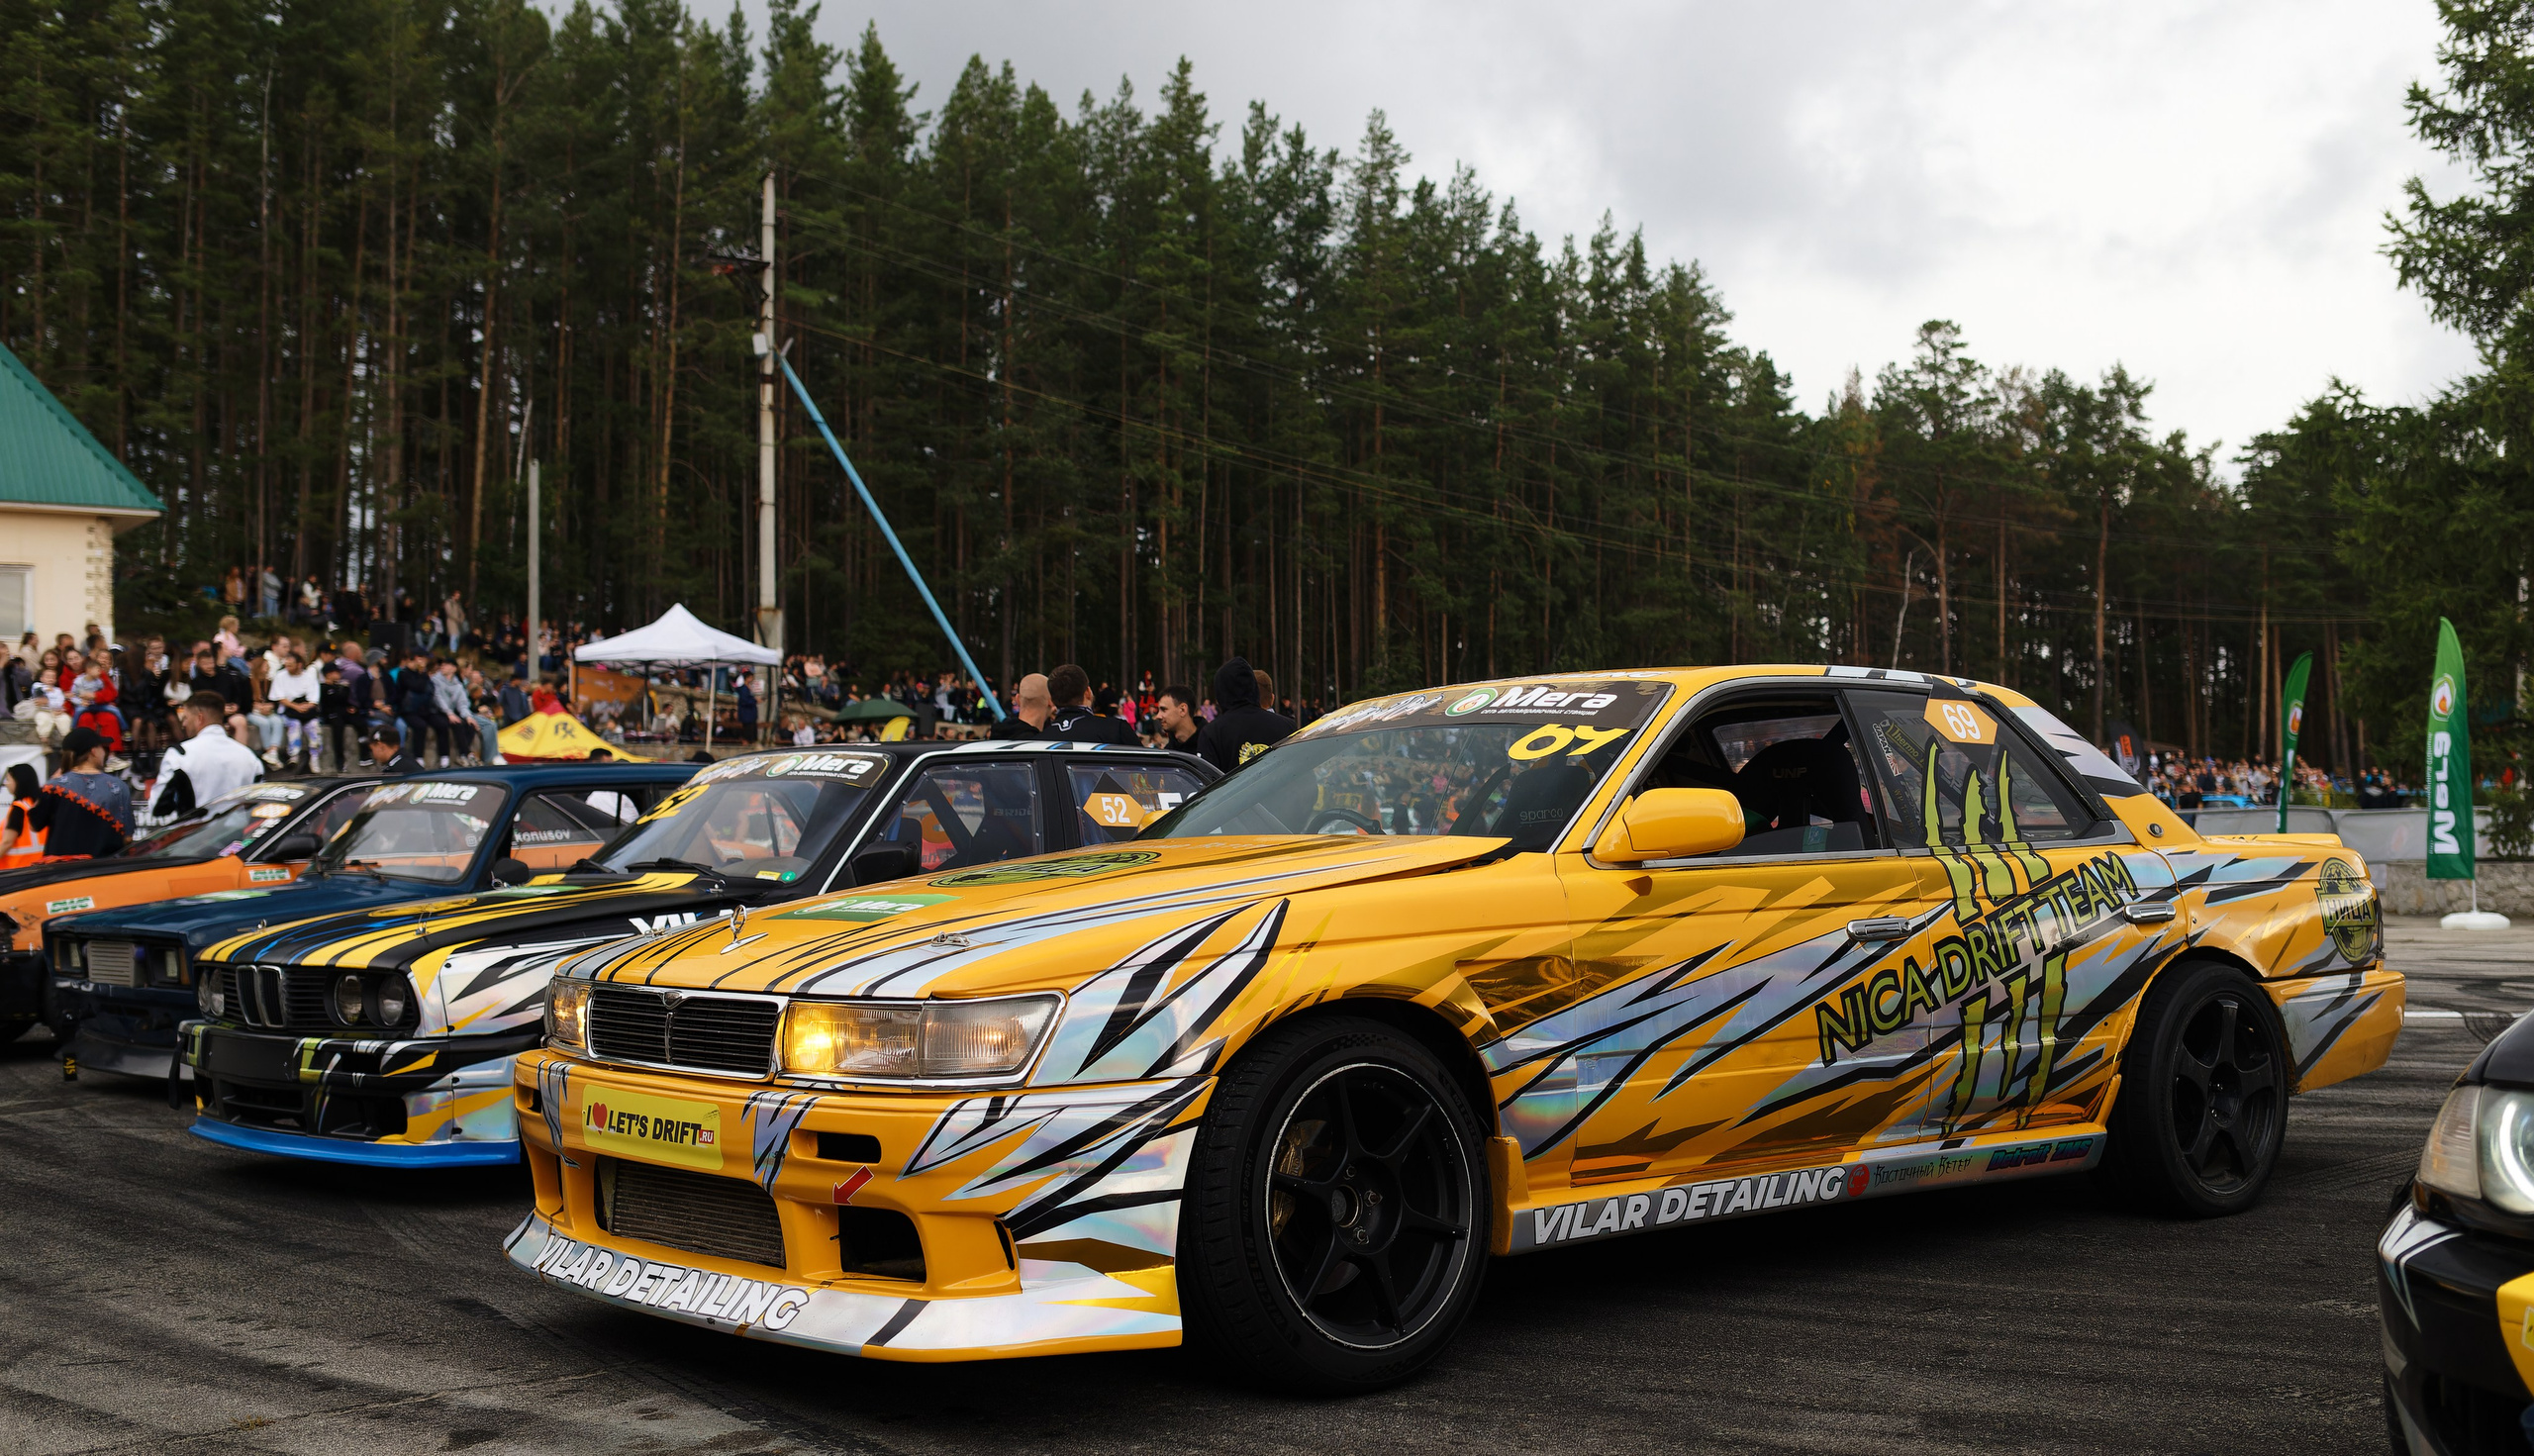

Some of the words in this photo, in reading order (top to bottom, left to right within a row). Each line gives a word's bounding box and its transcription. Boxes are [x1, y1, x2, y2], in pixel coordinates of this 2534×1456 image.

[1942, 703, 1982, 740] 69
[1101, 796, 1131, 825] 52
[2325, 899, 2372, 922] НИЦА
[1815, 955, 1940, 1068] NICA
[1933, 896, 2045, 1004] DRIFT
[2039, 851, 2142, 938] TEAM
[586, 1105, 592, 1126] I
[608, 1110, 649, 1138] LET'S
[1534, 1193, 1652, 1246] VILAR
[1656, 1166, 1847, 1226] DETAILING
[531, 1234, 615, 1291] VILAR
[603, 1257, 810, 1331] DETAILING
